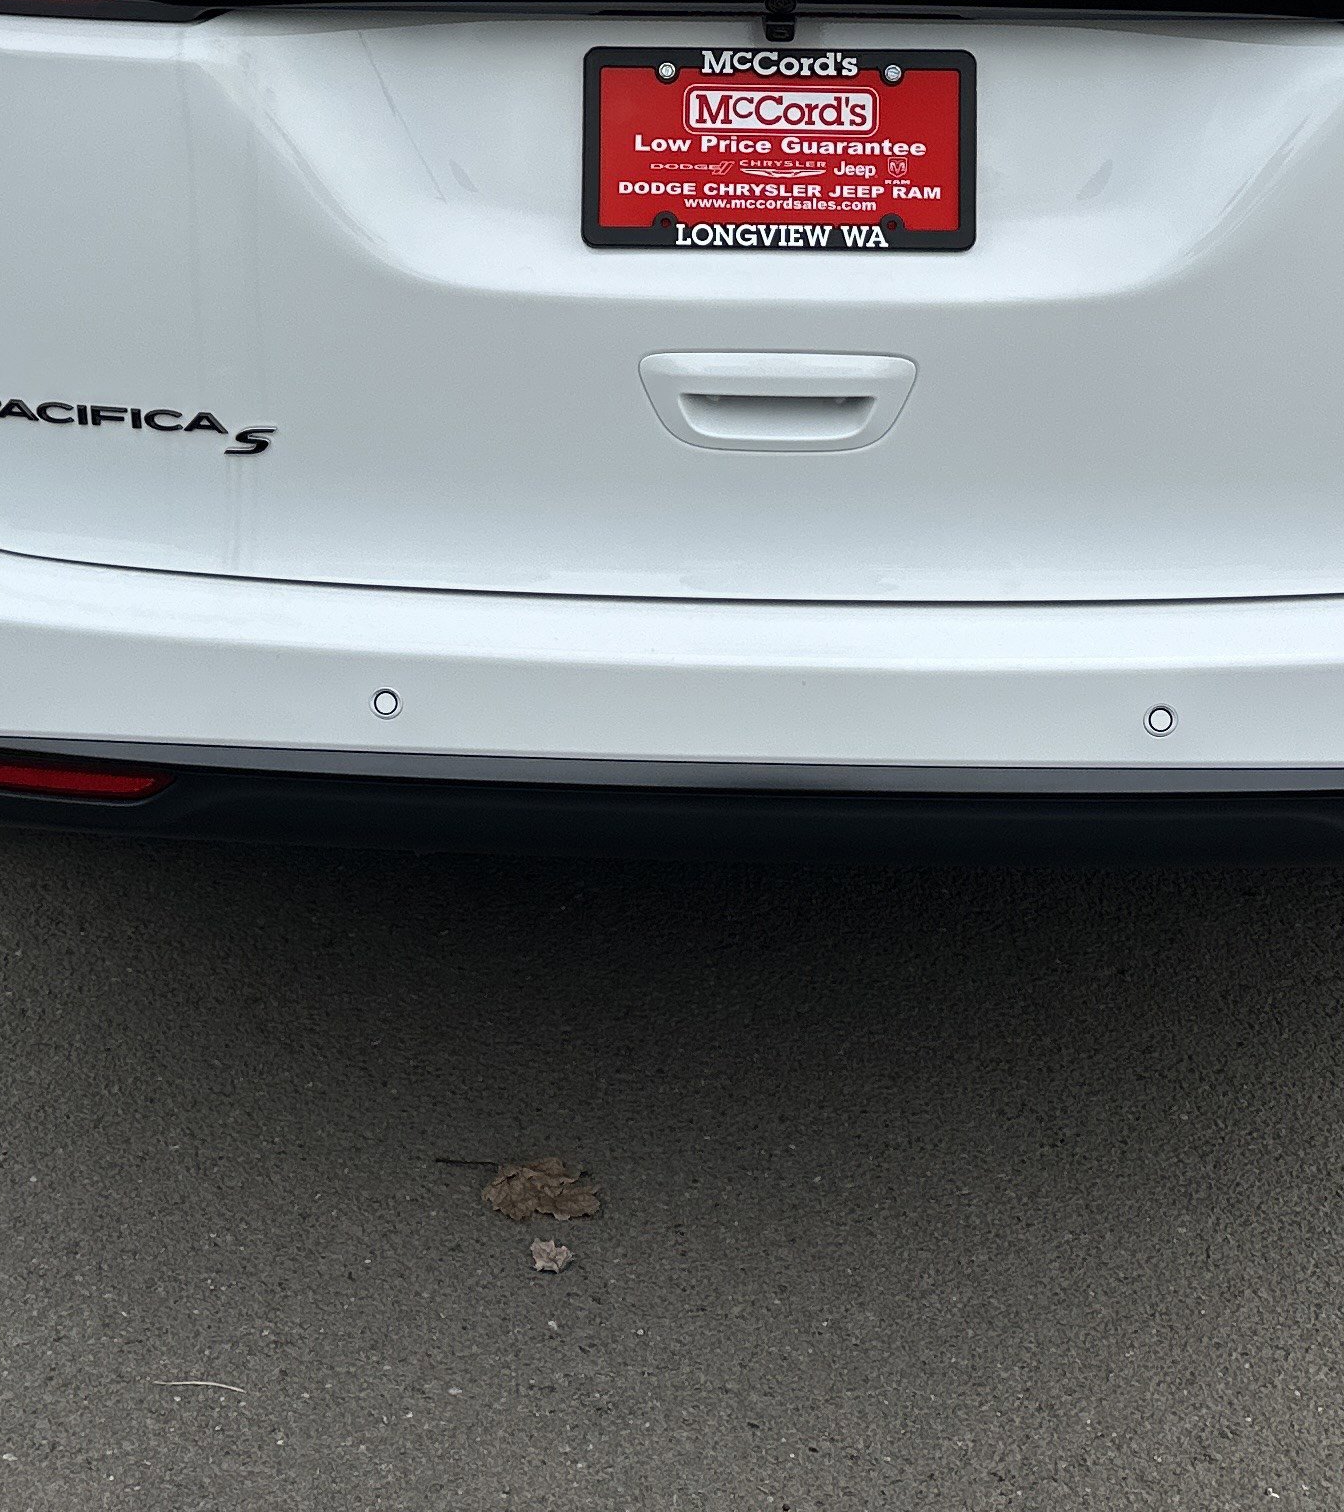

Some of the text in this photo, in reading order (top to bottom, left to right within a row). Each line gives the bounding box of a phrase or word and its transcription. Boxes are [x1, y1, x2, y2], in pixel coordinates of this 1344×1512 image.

[701, 50, 858, 76] McCord's
[695, 94, 867, 127] McCord's
[634, 134, 927, 156] Low Price Guarantee
[739, 159, 827, 168] CHRYSLER
[833, 161, 876, 179] Jeep
[618, 181, 941, 199] DODGE CHRYSLER JEEP RAM
[684, 197, 877, 211] www.mccordsales.com
[675, 223, 889, 248] LONGVIEW WA
[224, 426, 278, 455] S
